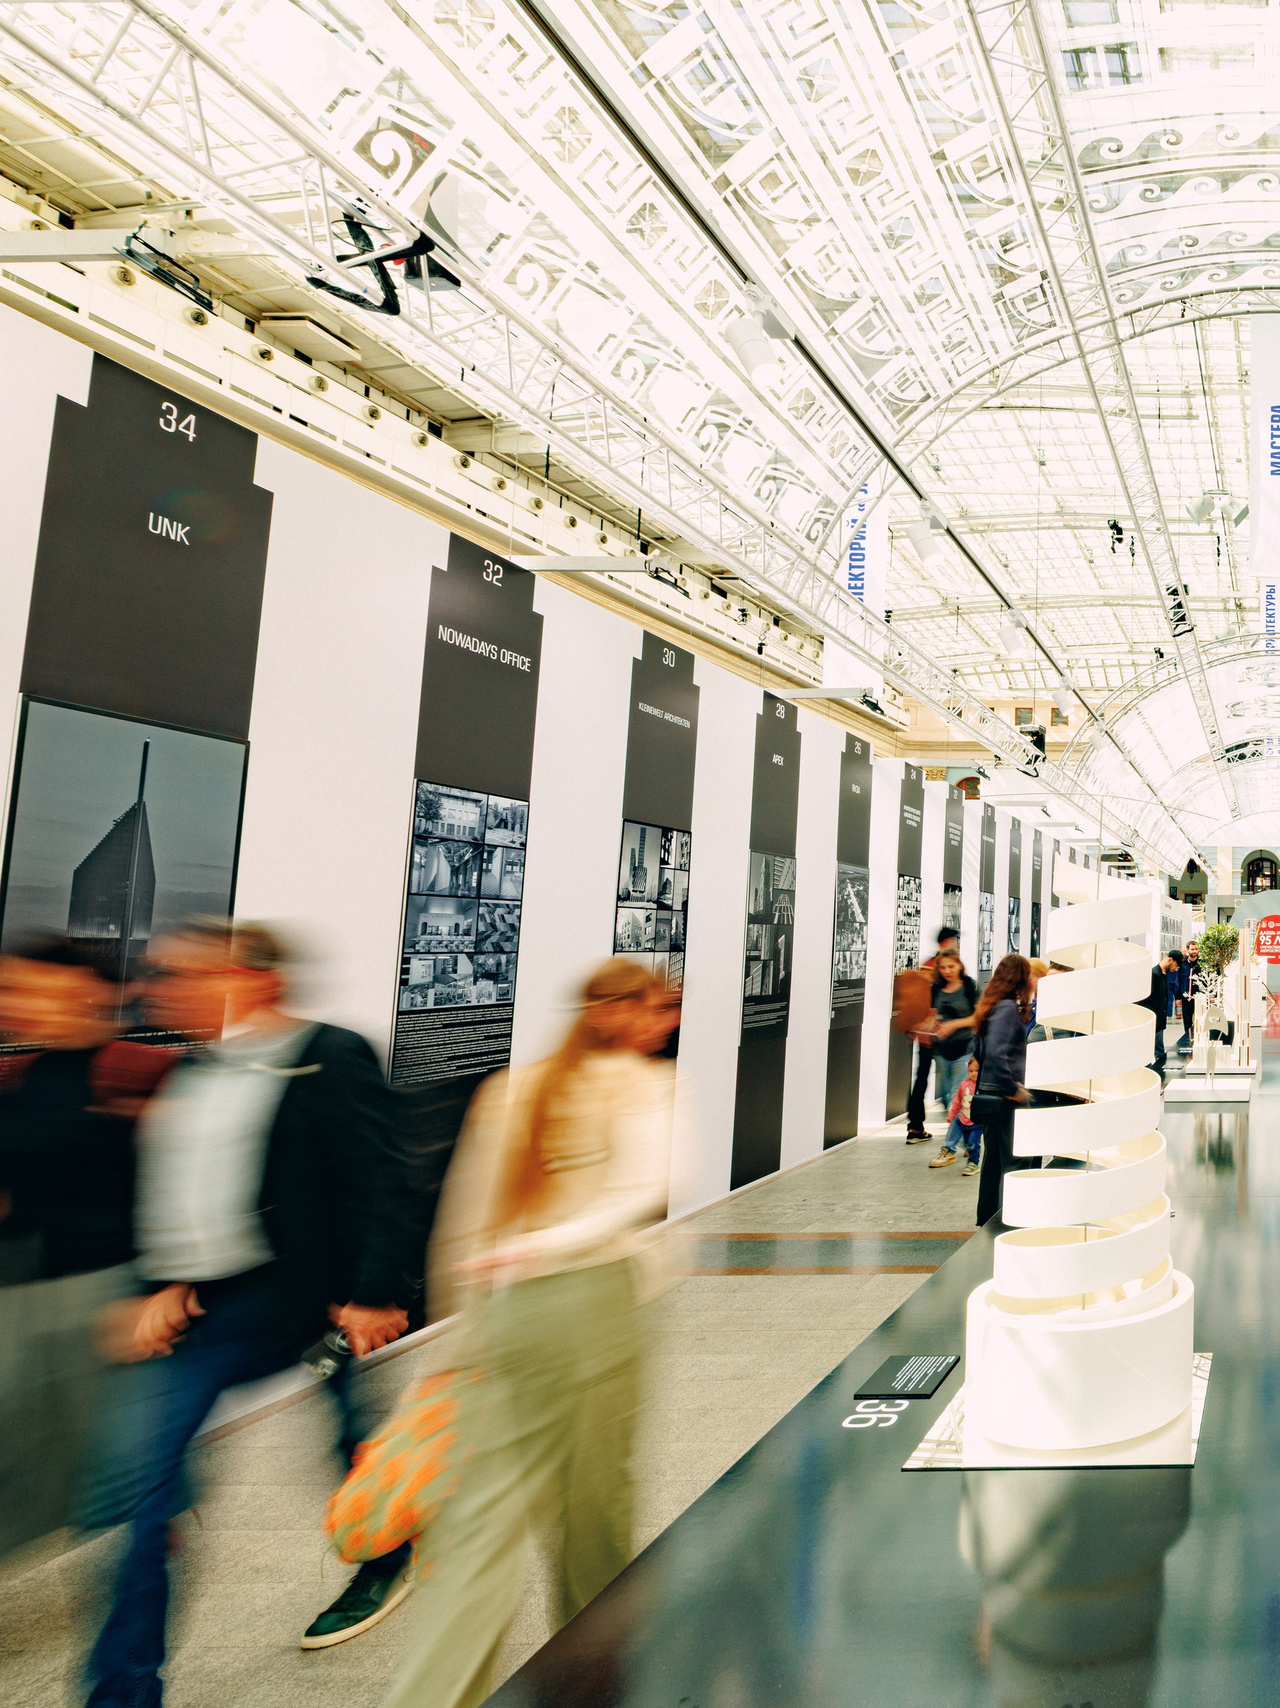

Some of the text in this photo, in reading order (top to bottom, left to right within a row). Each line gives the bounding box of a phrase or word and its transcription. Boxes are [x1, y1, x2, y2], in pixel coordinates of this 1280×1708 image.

[158, 401, 197, 442] 34
[148, 511, 191, 546] UNK
[482, 559, 504, 587] 32
[438, 624, 532, 673] NOWADAYS OFFICE
[662, 647, 676, 668] 30
[775, 703, 786, 719] 28
[772, 753, 784, 767] APEX
[854, 741, 862, 755] 26
[1259, 935, 1272, 946] 95
[842, 1399, 910, 1428] 36
